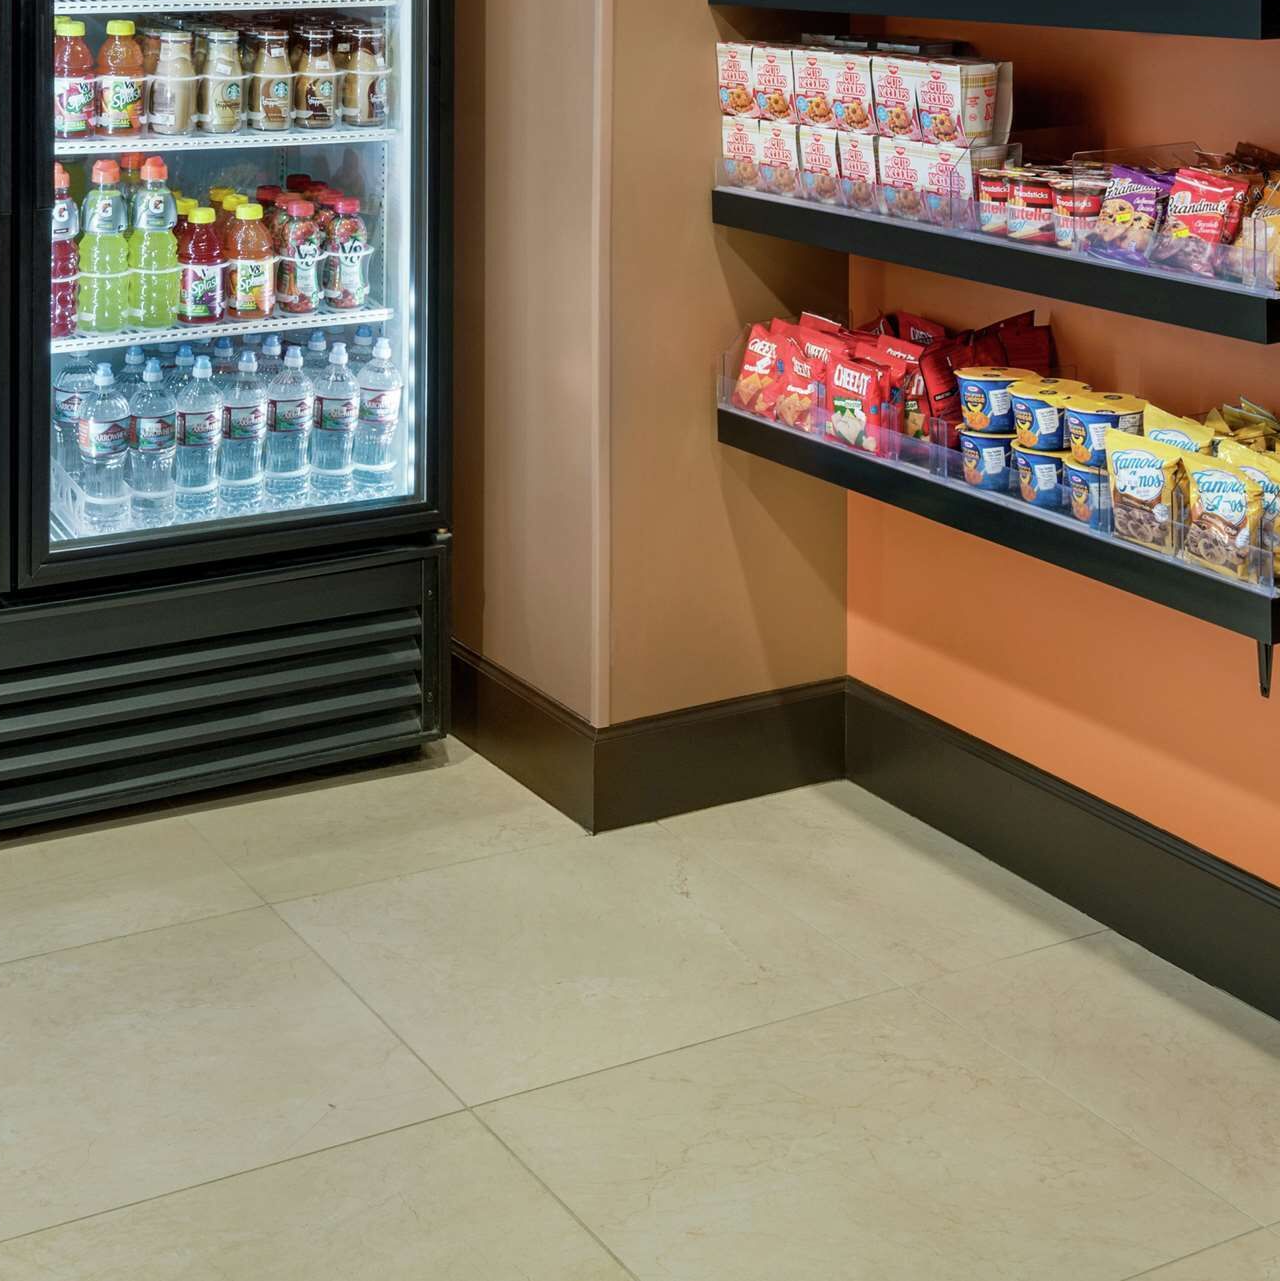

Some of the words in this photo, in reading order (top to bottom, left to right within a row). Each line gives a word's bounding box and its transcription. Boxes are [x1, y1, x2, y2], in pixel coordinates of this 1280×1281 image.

[764, 64, 780, 76] CUP
[803, 66, 821, 79] CUP
[884, 75, 902, 88] CUP
[927, 80, 947, 94] CUP
[891, 157, 911, 170] CUP
[834, 364, 871, 398] CHEEZ-IT
[1112, 451, 1165, 471] Famous
[1193, 470, 1247, 494] Famous
